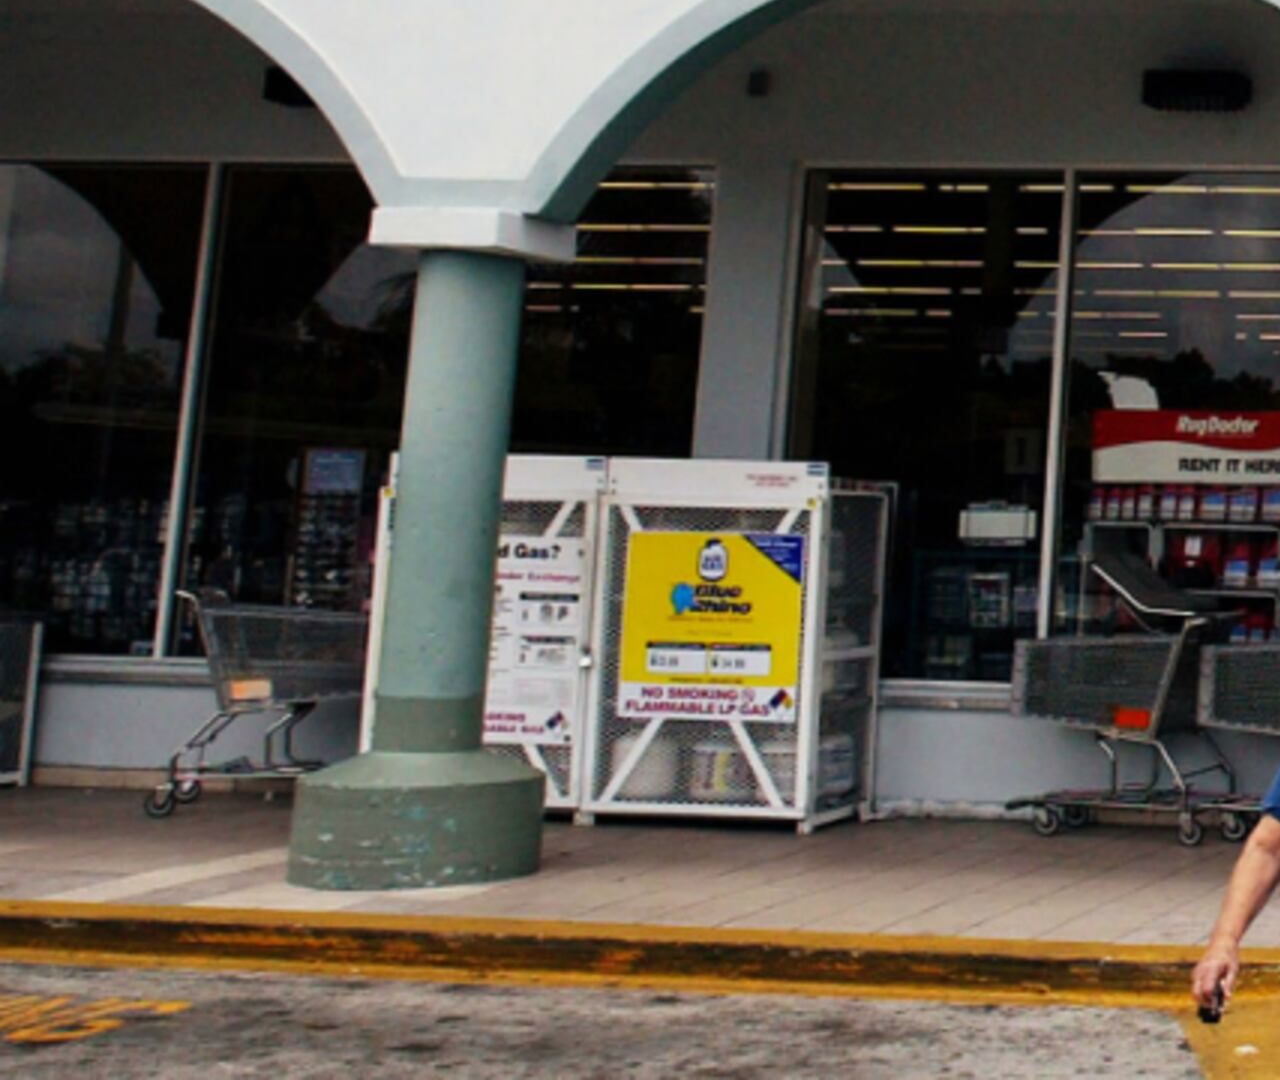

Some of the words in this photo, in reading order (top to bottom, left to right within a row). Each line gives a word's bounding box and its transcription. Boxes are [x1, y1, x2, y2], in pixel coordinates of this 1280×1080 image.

[1178, 458, 1221, 472] RENT
[1226, 459, 1241, 472] IT
[514, 542, 561, 559] Gas?
[641, 686, 664, 698] NO
[667, 687, 738, 701] SMOKING
[625, 700, 715, 715] FLAMMABLE
[718, 704, 736, 715] LP
[739, 704, 770, 716] GAS
